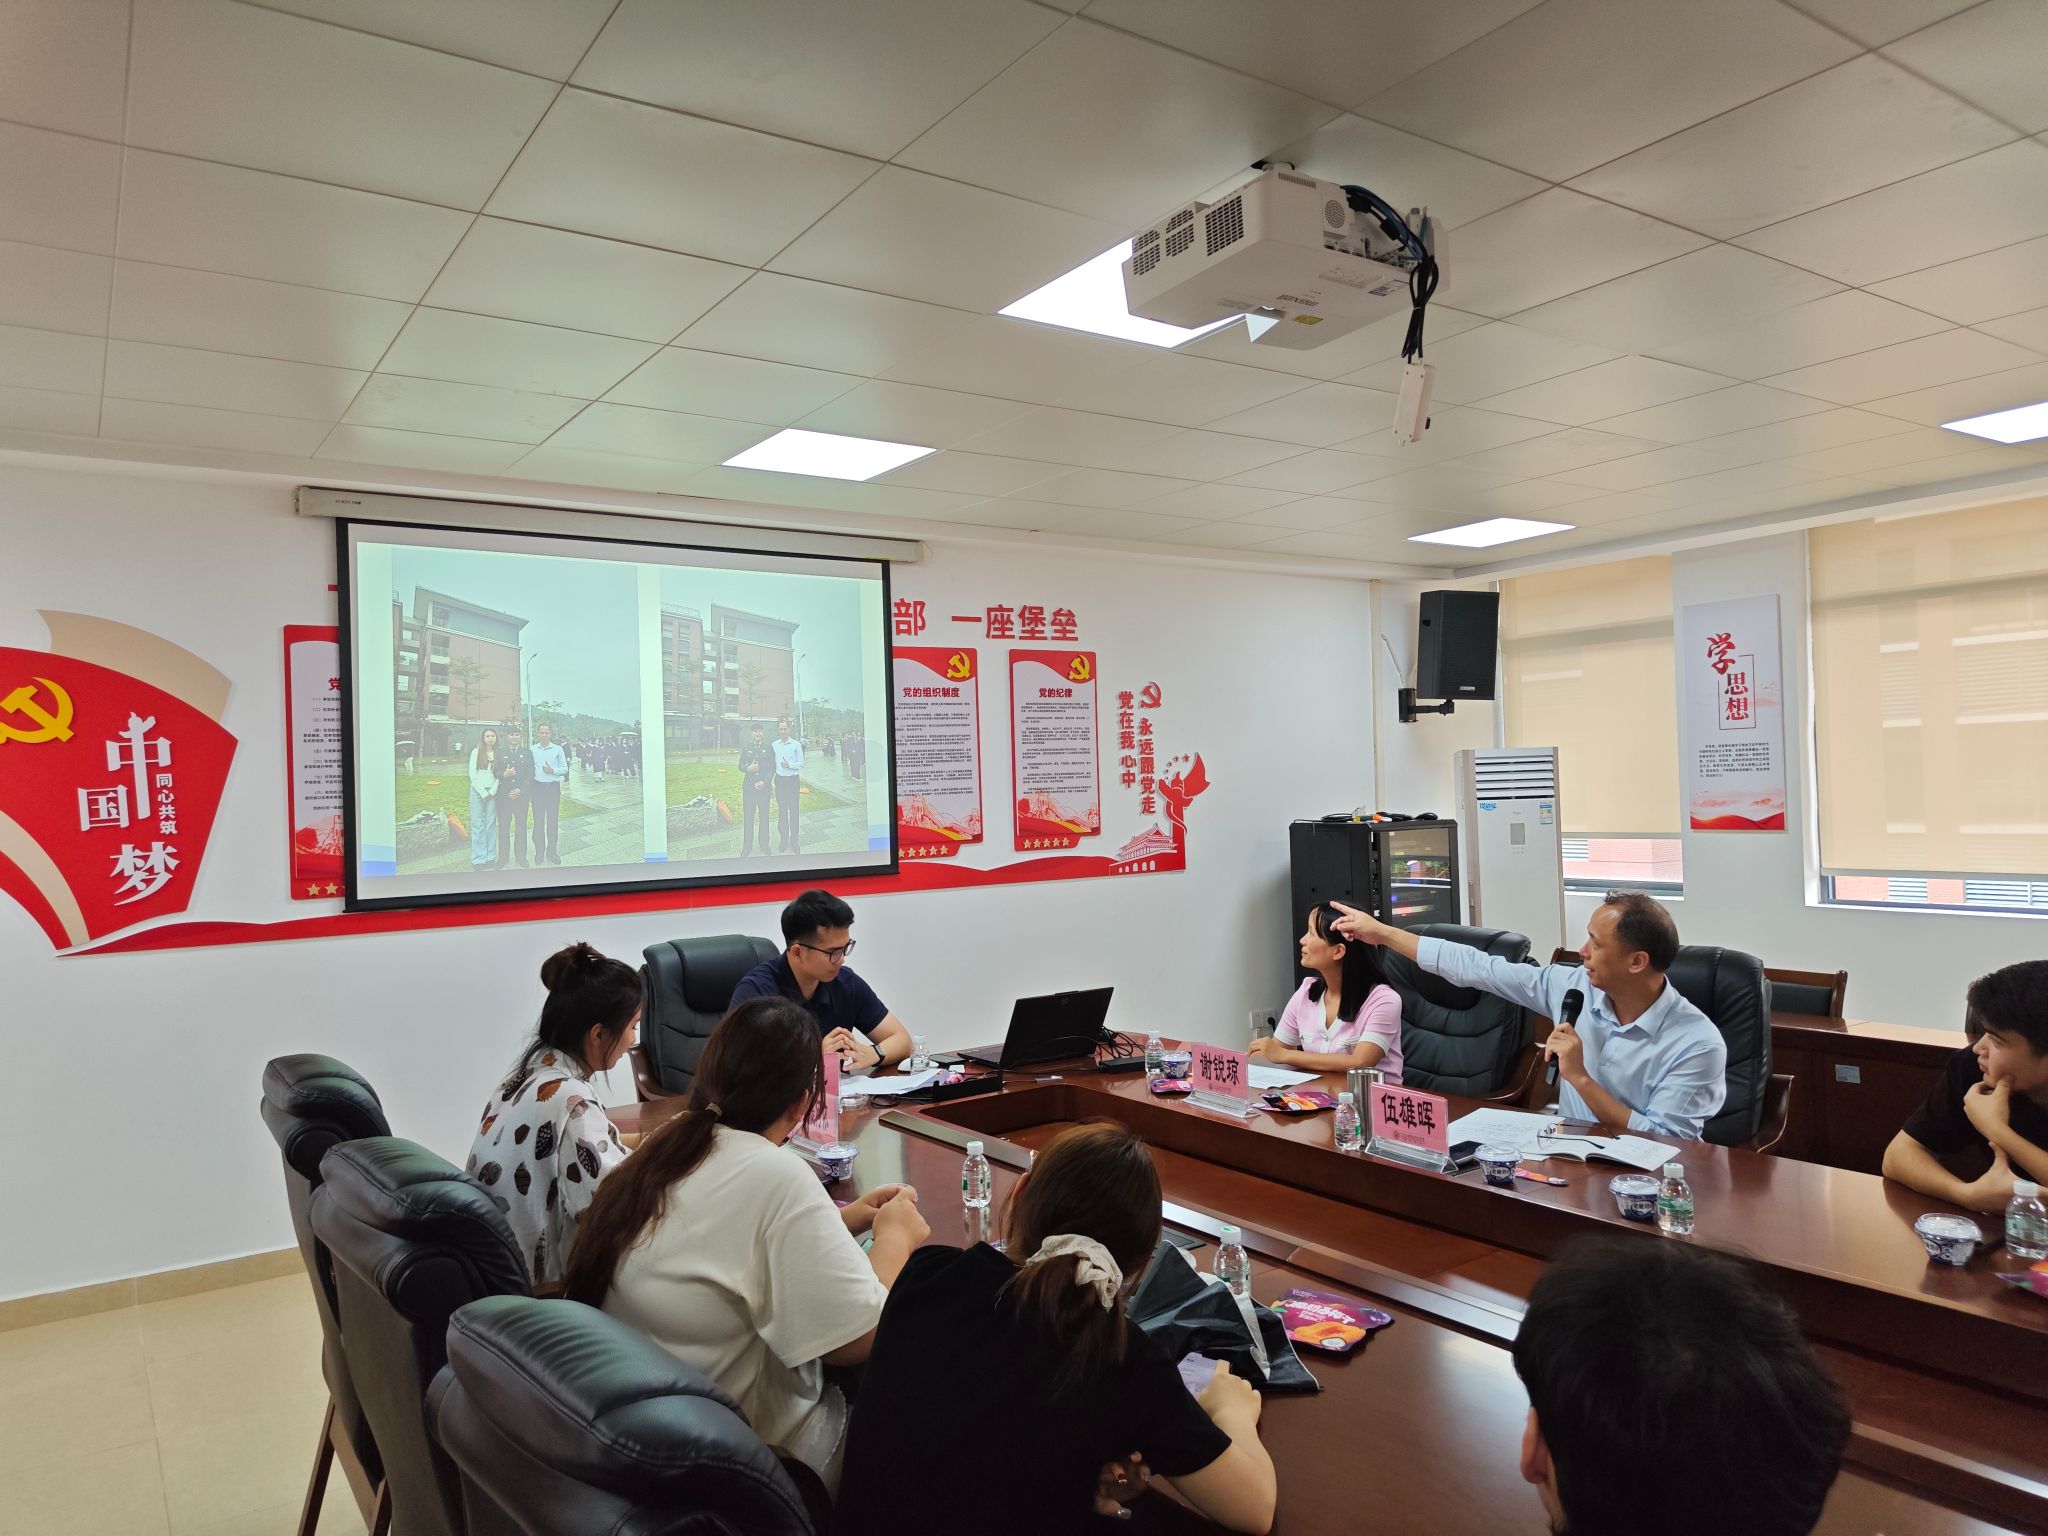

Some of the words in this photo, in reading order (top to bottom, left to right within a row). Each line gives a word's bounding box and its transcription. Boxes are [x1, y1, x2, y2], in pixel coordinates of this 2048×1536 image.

[893, 598, 926, 636] 部
[951, 604, 1079, 641] 一座堡垒
[902, 686, 960, 698] 党的组织制度
[1039, 687, 1073, 698] 党的纪律
[1706, 632, 1749, 721] 学思想
[1118, 690, 1137, 789] 党在我心中
[1138, 717, 1157, 815] 永远跟党走
[77, 711, 181, 906] 中国梦
[155, 773, 178, 835] 同心共筑
[1200, 1051, 1241, 1085] 谢锐琼
[1381, 1092, 1436, 1135] 伍雄晖
